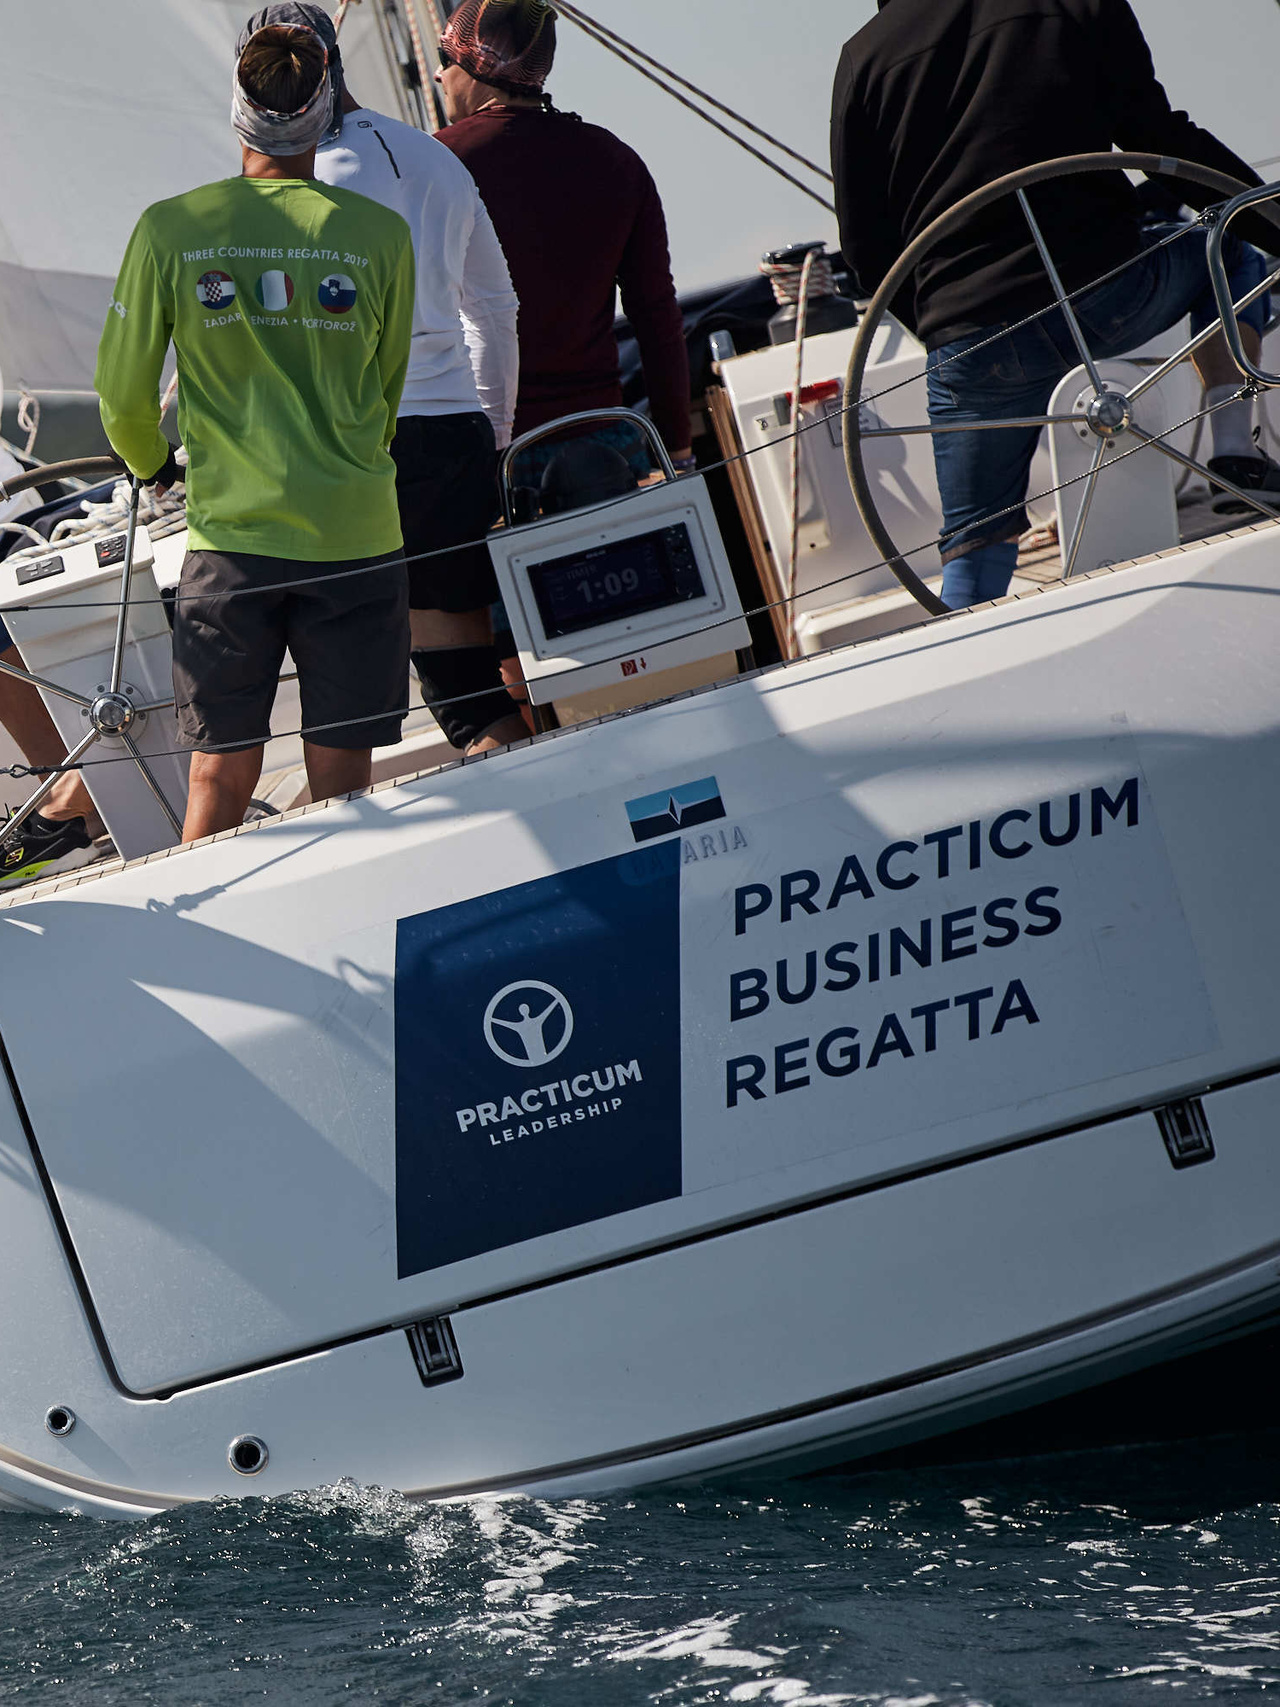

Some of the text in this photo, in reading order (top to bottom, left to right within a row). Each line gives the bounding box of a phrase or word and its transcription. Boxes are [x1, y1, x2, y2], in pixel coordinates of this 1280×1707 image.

[182, 247, 369, 268] THREE COUNTRIES REGATTA 2019
[204, 314, 243, 328] ZADAR
[578, 568, 638, 602] 1:09
[733, 776, 1142, 937] PRACTICUM
[729, 886, 1063, 1022] BUSINESS
[725, 978, 1041, 1108] REGATTA
[455, 1058, 644, 1133] PRACTICUM
[489, 1096, 625, 1146] LEADERSHIP
